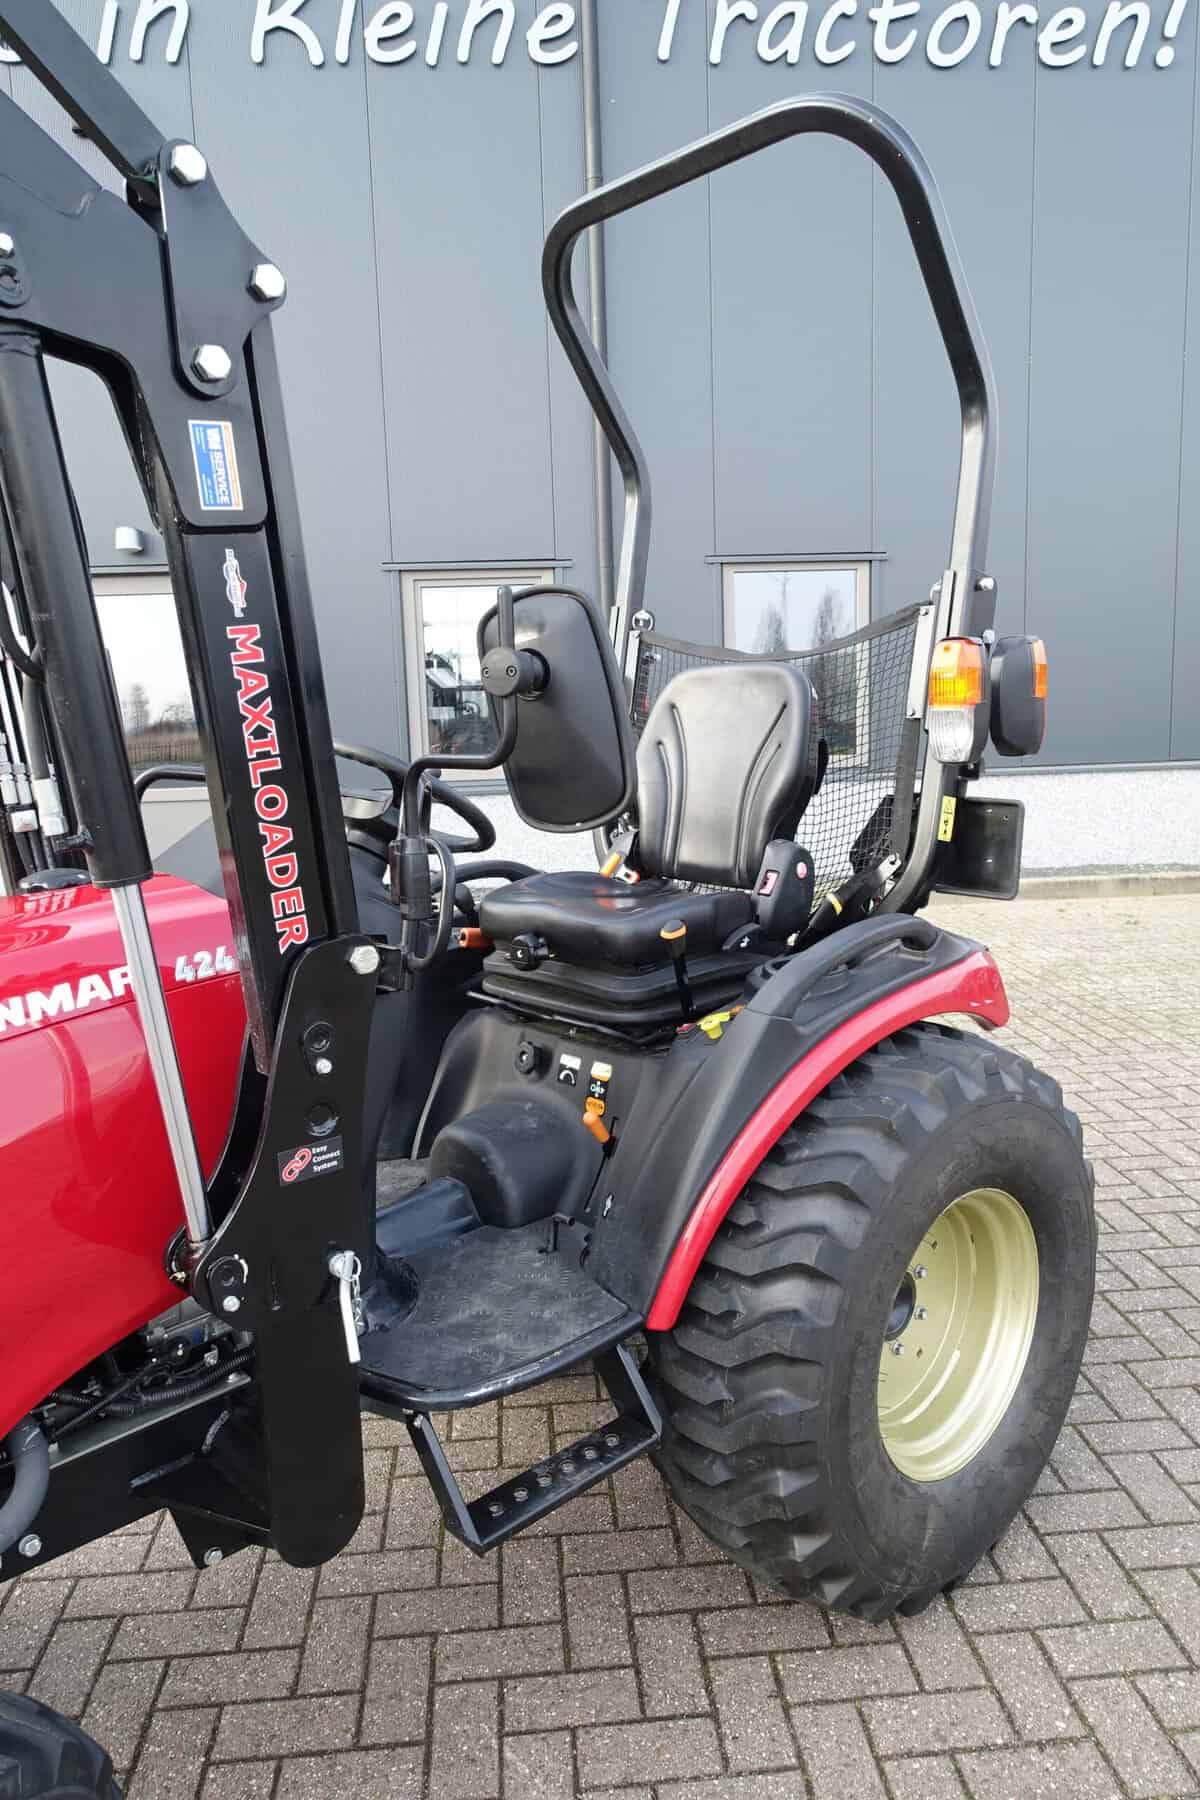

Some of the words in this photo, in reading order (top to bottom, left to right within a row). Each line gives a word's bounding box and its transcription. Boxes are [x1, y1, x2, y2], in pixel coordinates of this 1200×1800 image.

[251, 0, 578, 66] Kleine
[226, 623, 310, 955] MAXILOADER
[175, 945, 236, 983] 424
[313, 1160, 338, 1172] System
